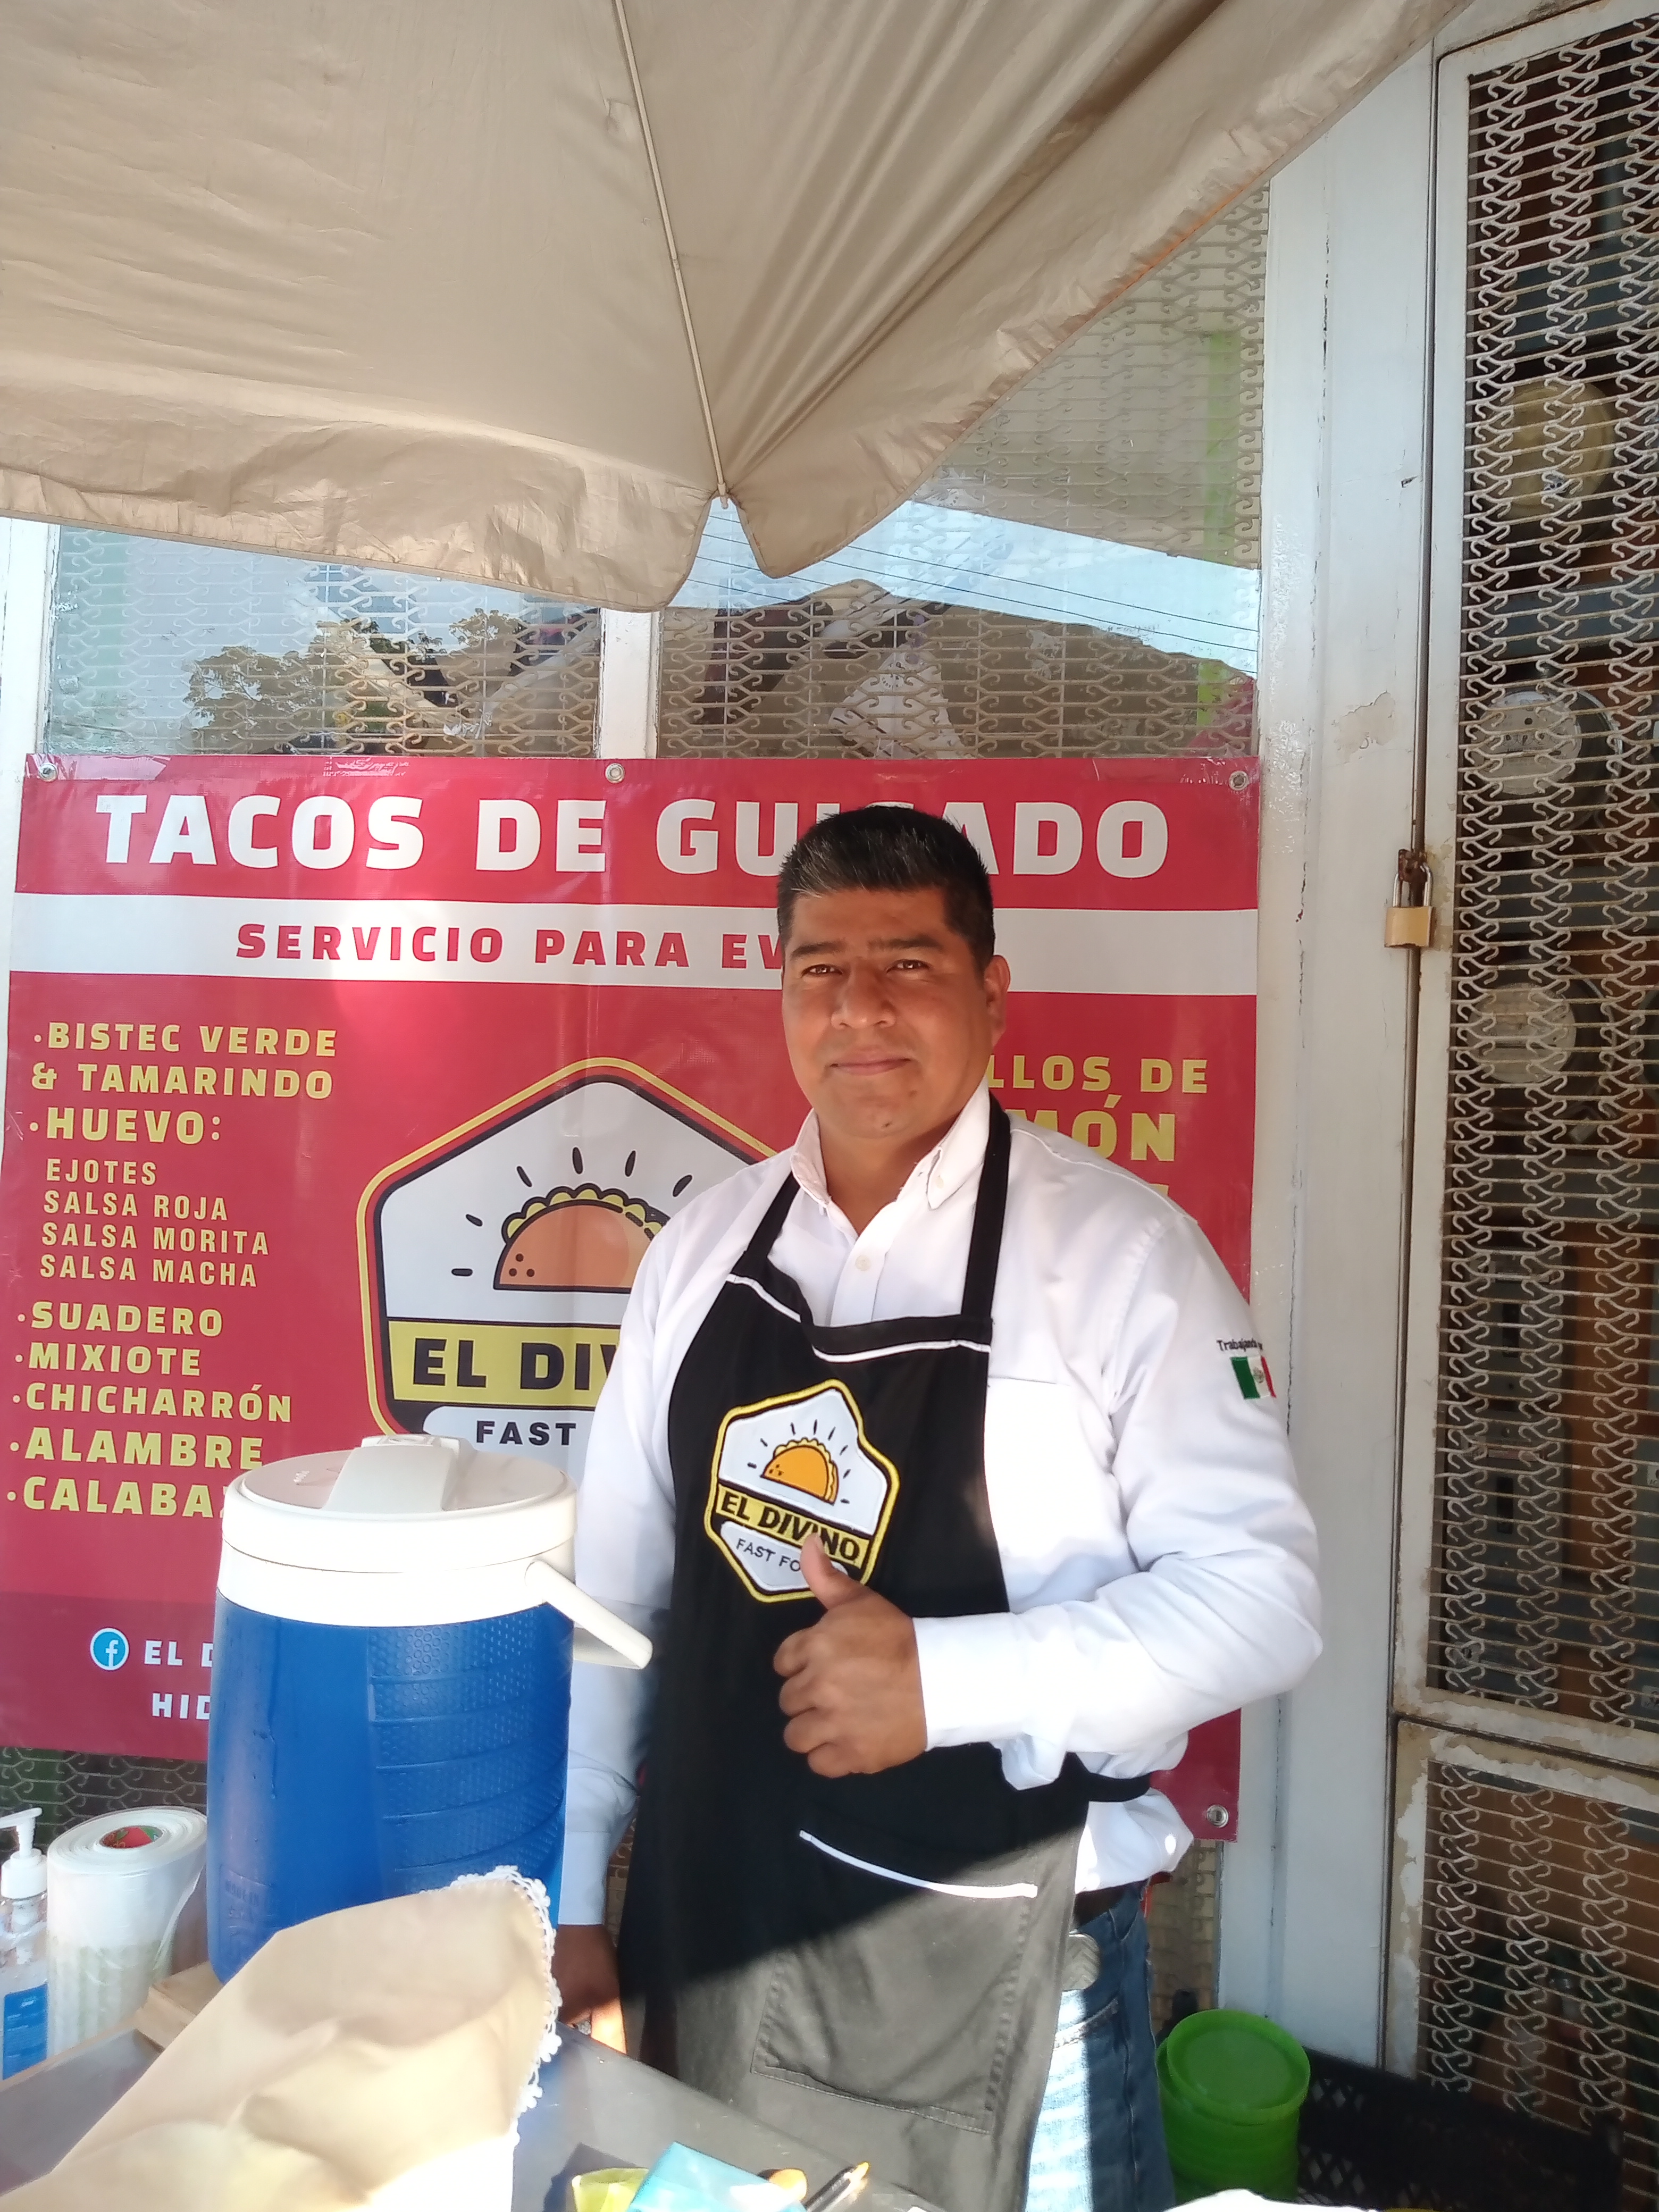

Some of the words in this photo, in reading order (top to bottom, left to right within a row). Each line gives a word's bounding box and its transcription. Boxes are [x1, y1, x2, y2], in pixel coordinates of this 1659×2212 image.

[96, 794, 424, 870] TACOS
[475, 799, 609, 873] DE
[656, 799, 1169, 879] GUADO
[237, 923, 504, 963] SERVICIO
[534, 929, 690, 968] PARA
[48, 1022, 180, 1052] BISTEC
[199, 1025, 337, 1057] VERDE
[31, 1062, 57, 1090] &
[78, 1063, 333, 1099] TAMARINDO
[1140, 1058, 1208, 1093] DE
[46, 1107, 221, 1144] HUEVO:
[46, 1158, 157, 1185] EJOTES
[44, 1190, 138, 1217] SALSA
[154, 1194, 228, 1221] ROJA
[41, 1222, 137, 1249] SALSA
[153, 1227, 269, 1255] MORITA
[40, 1254, 136, 1280] SALSA
[153, 1259, 257, 1287] MACHA
[31, 1301, 223, 1337] SUADERO
[28, 1342, 201, 1376] MIXIOTE
[413, 1337, 487, 1388] EL
[26, 1382, 291, 1422] CHICHARRÓN
[24, 1427, 263, 1469] ALAMBRE
[476, 1420, 576, 1446] FAST
[23, 1476, 224, 1518] CALABA
[722, 1492, 750, 1519] EL
[736, 1538, 776, 1562] FAST
[144, 1640, 183, 1666] EL
